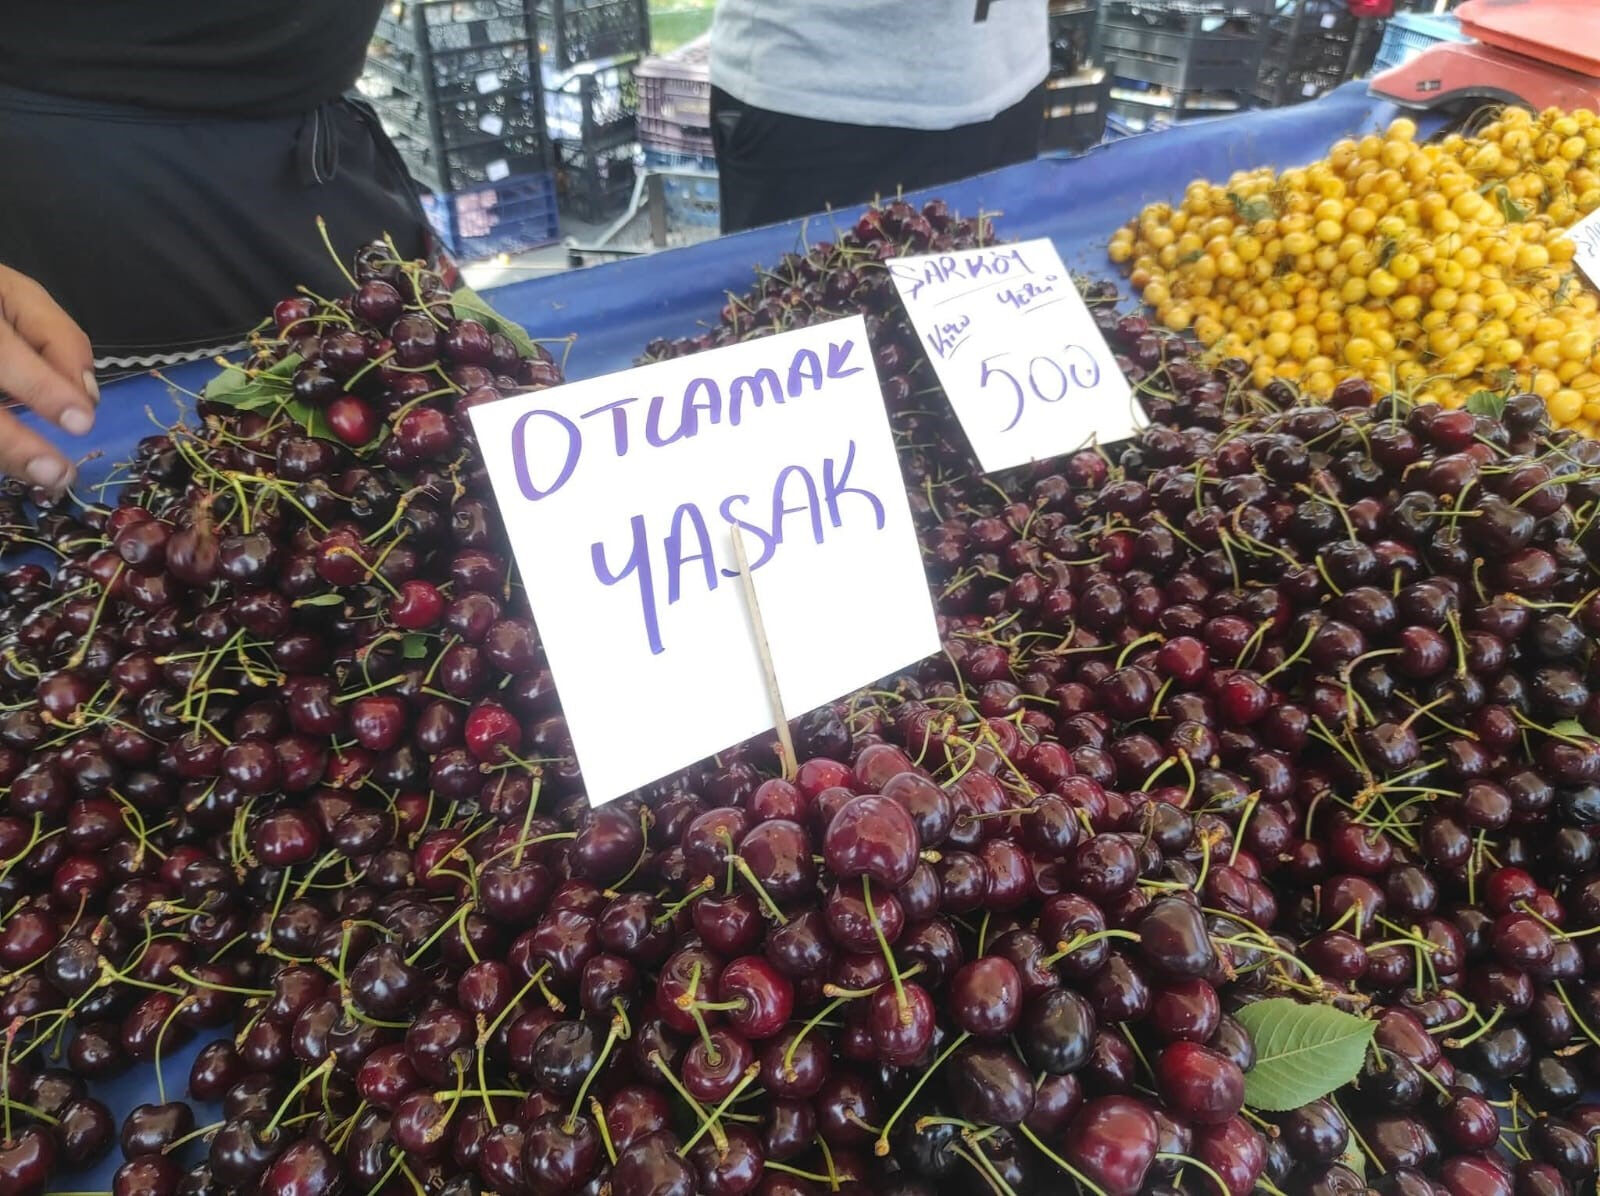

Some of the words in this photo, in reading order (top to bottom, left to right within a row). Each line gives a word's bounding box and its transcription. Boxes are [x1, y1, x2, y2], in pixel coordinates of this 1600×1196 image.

[512, 340, 864, 500] OTLAMAK
[980, 344, 1100, 432] 500
[591, 439, 885, 655] YASAK
